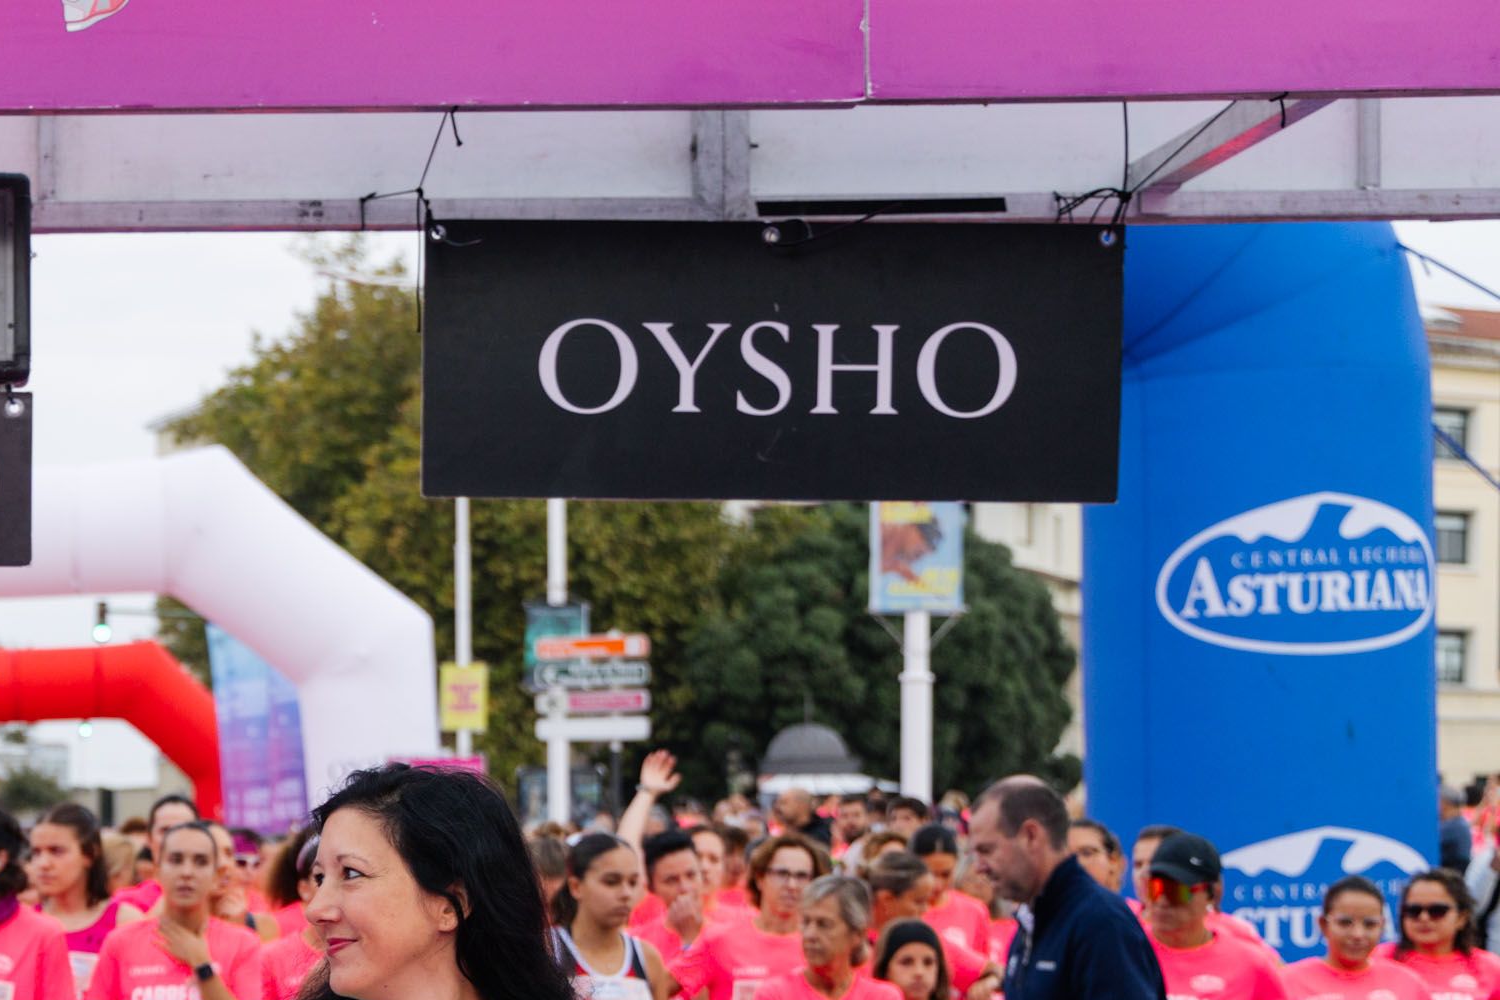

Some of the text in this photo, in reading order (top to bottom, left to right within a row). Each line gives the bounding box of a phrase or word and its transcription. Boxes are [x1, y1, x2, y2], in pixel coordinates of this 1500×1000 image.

[538, 319, 1017, 418] OYSHO
[1178, 556, 1428, 619] ASTURIANA
[1231, 548, 1340, 568] CENTRAL
